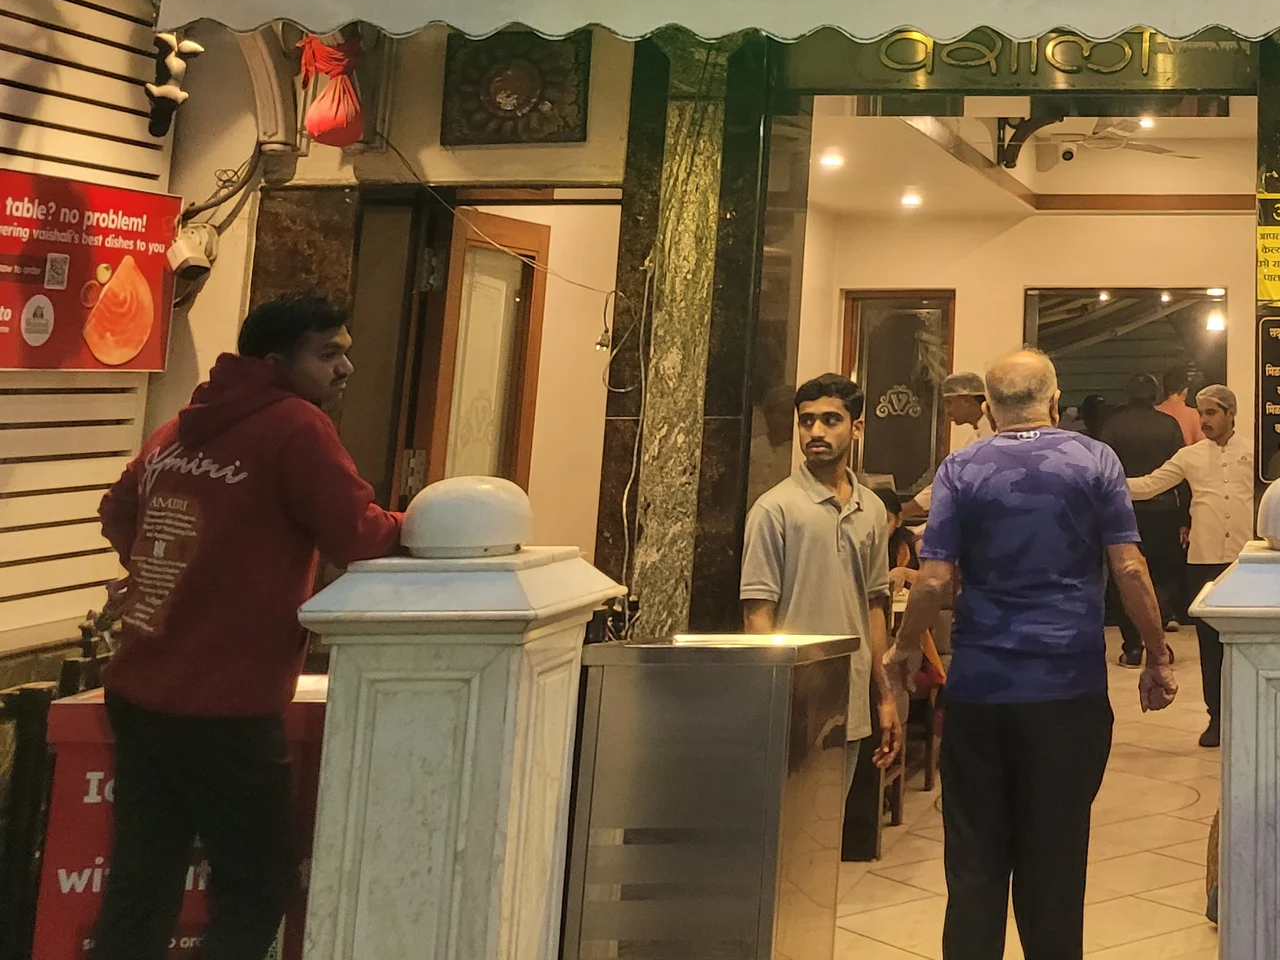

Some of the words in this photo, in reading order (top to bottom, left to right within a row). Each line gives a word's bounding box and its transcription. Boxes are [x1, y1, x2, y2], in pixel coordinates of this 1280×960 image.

[5, 197, 56, 221] table?
[59, 207, 80, 224] no
[83, 208, 148, 233] problem!
[82, 232, 103, 247] best
[105, 234, 134, 250] dishes
[136, 238, 146, 251] to
[149, 241, 165, 256] you
[57, 856, 110, 894] wi
